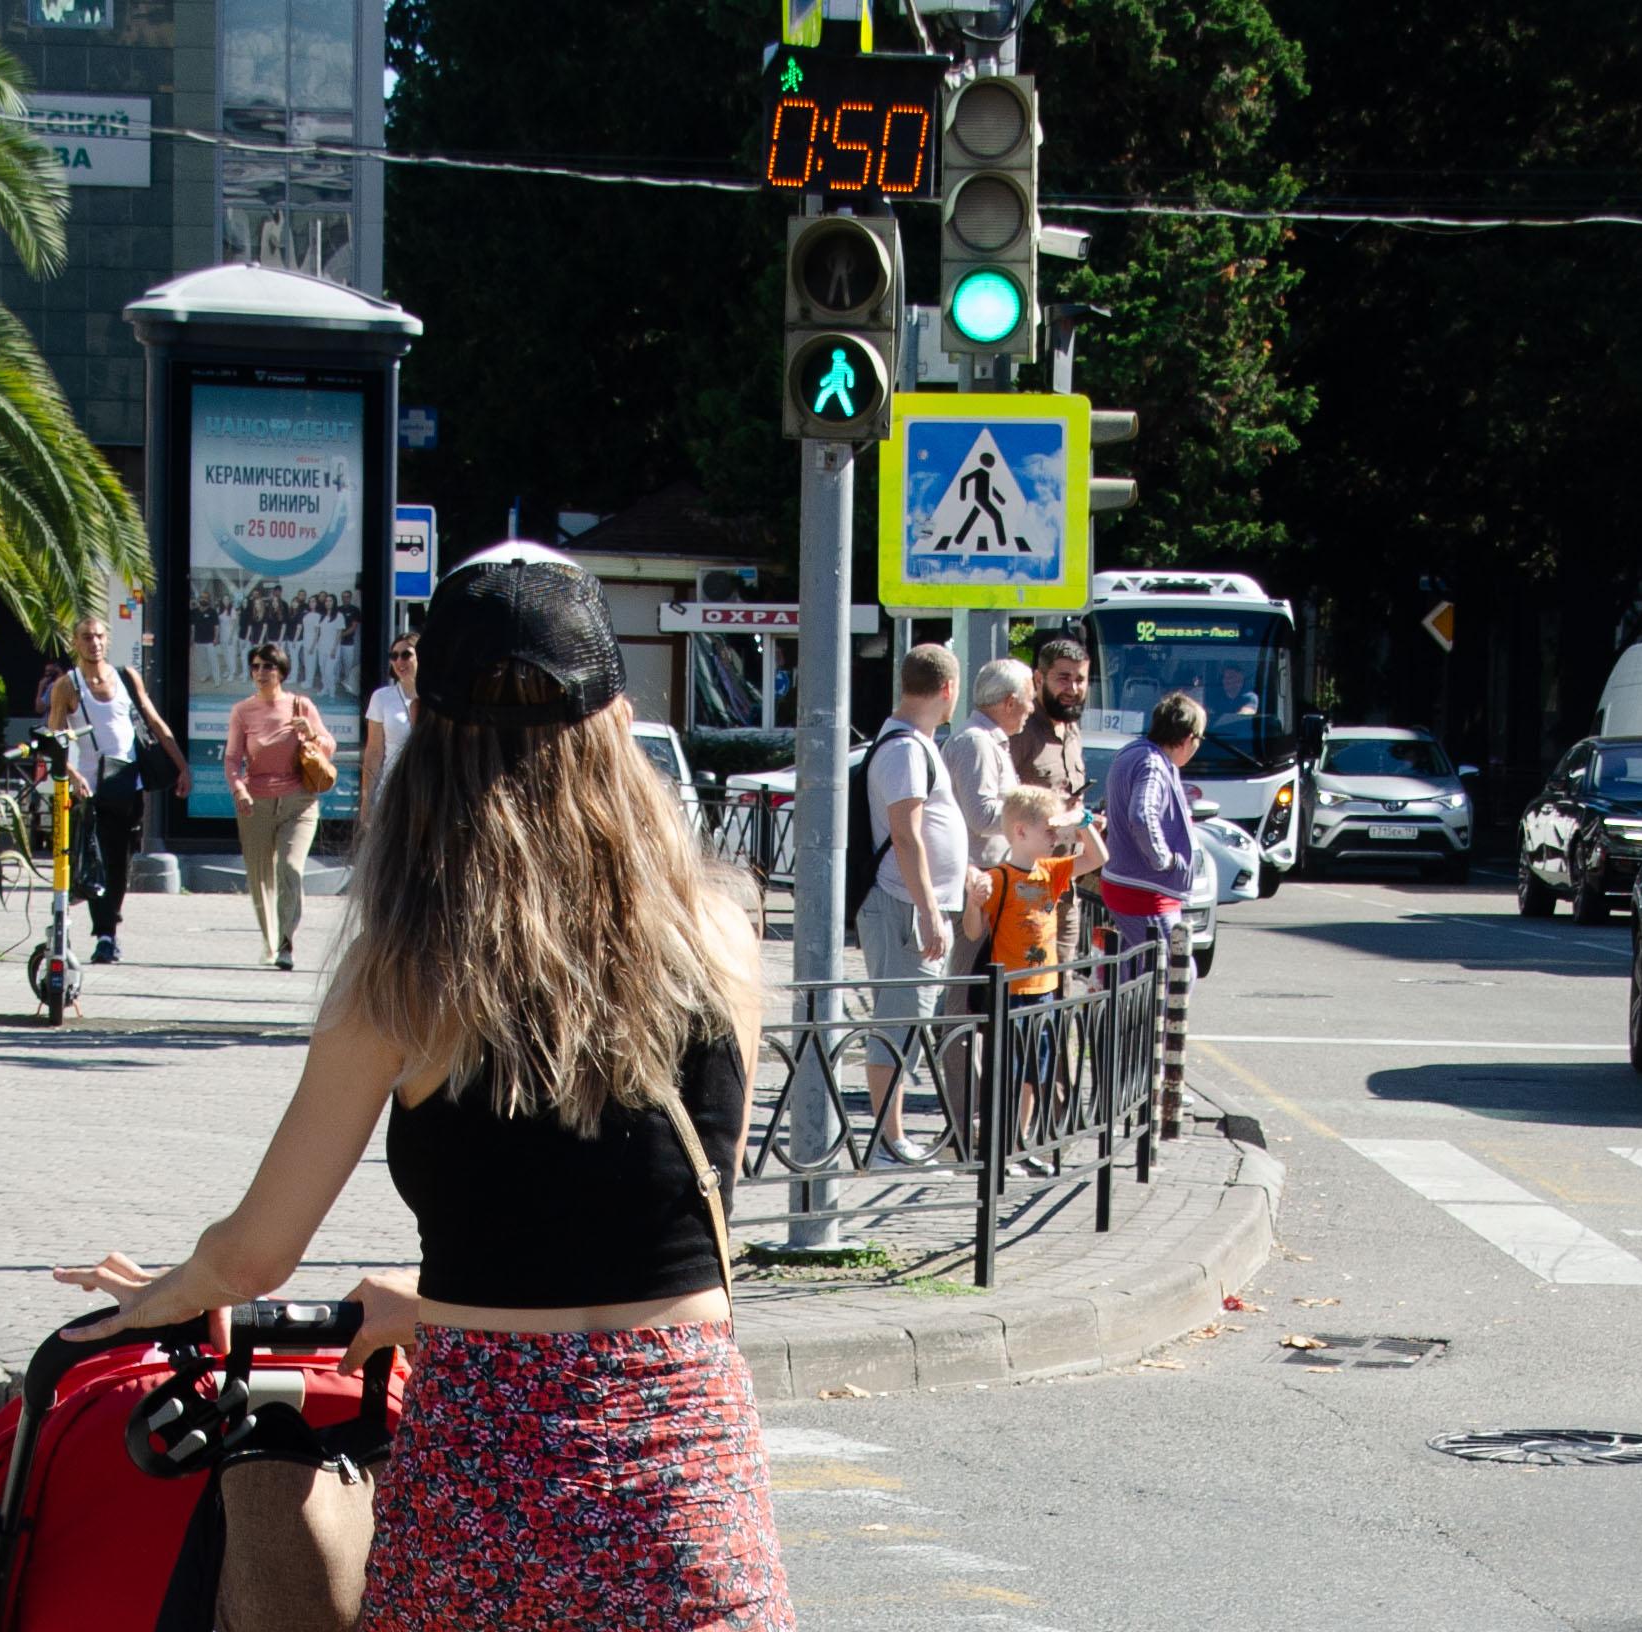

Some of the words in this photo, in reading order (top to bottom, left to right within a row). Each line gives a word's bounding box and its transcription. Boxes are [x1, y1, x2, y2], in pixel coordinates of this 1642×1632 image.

[768, 98, 929, 193] 0:50
[205, 465, 320, 489] КЕРАМИЧЕСКИЕ
[259, 493, 320, 514] ВИНИРЫ
[248, 520, 265, 538] 25
[270, 520, 296, 539] 000
[706, 611, 800, 624] ОХРА
[1137, 621, 1156, 641] 92
[1104, 715, 1121, 730] 92
